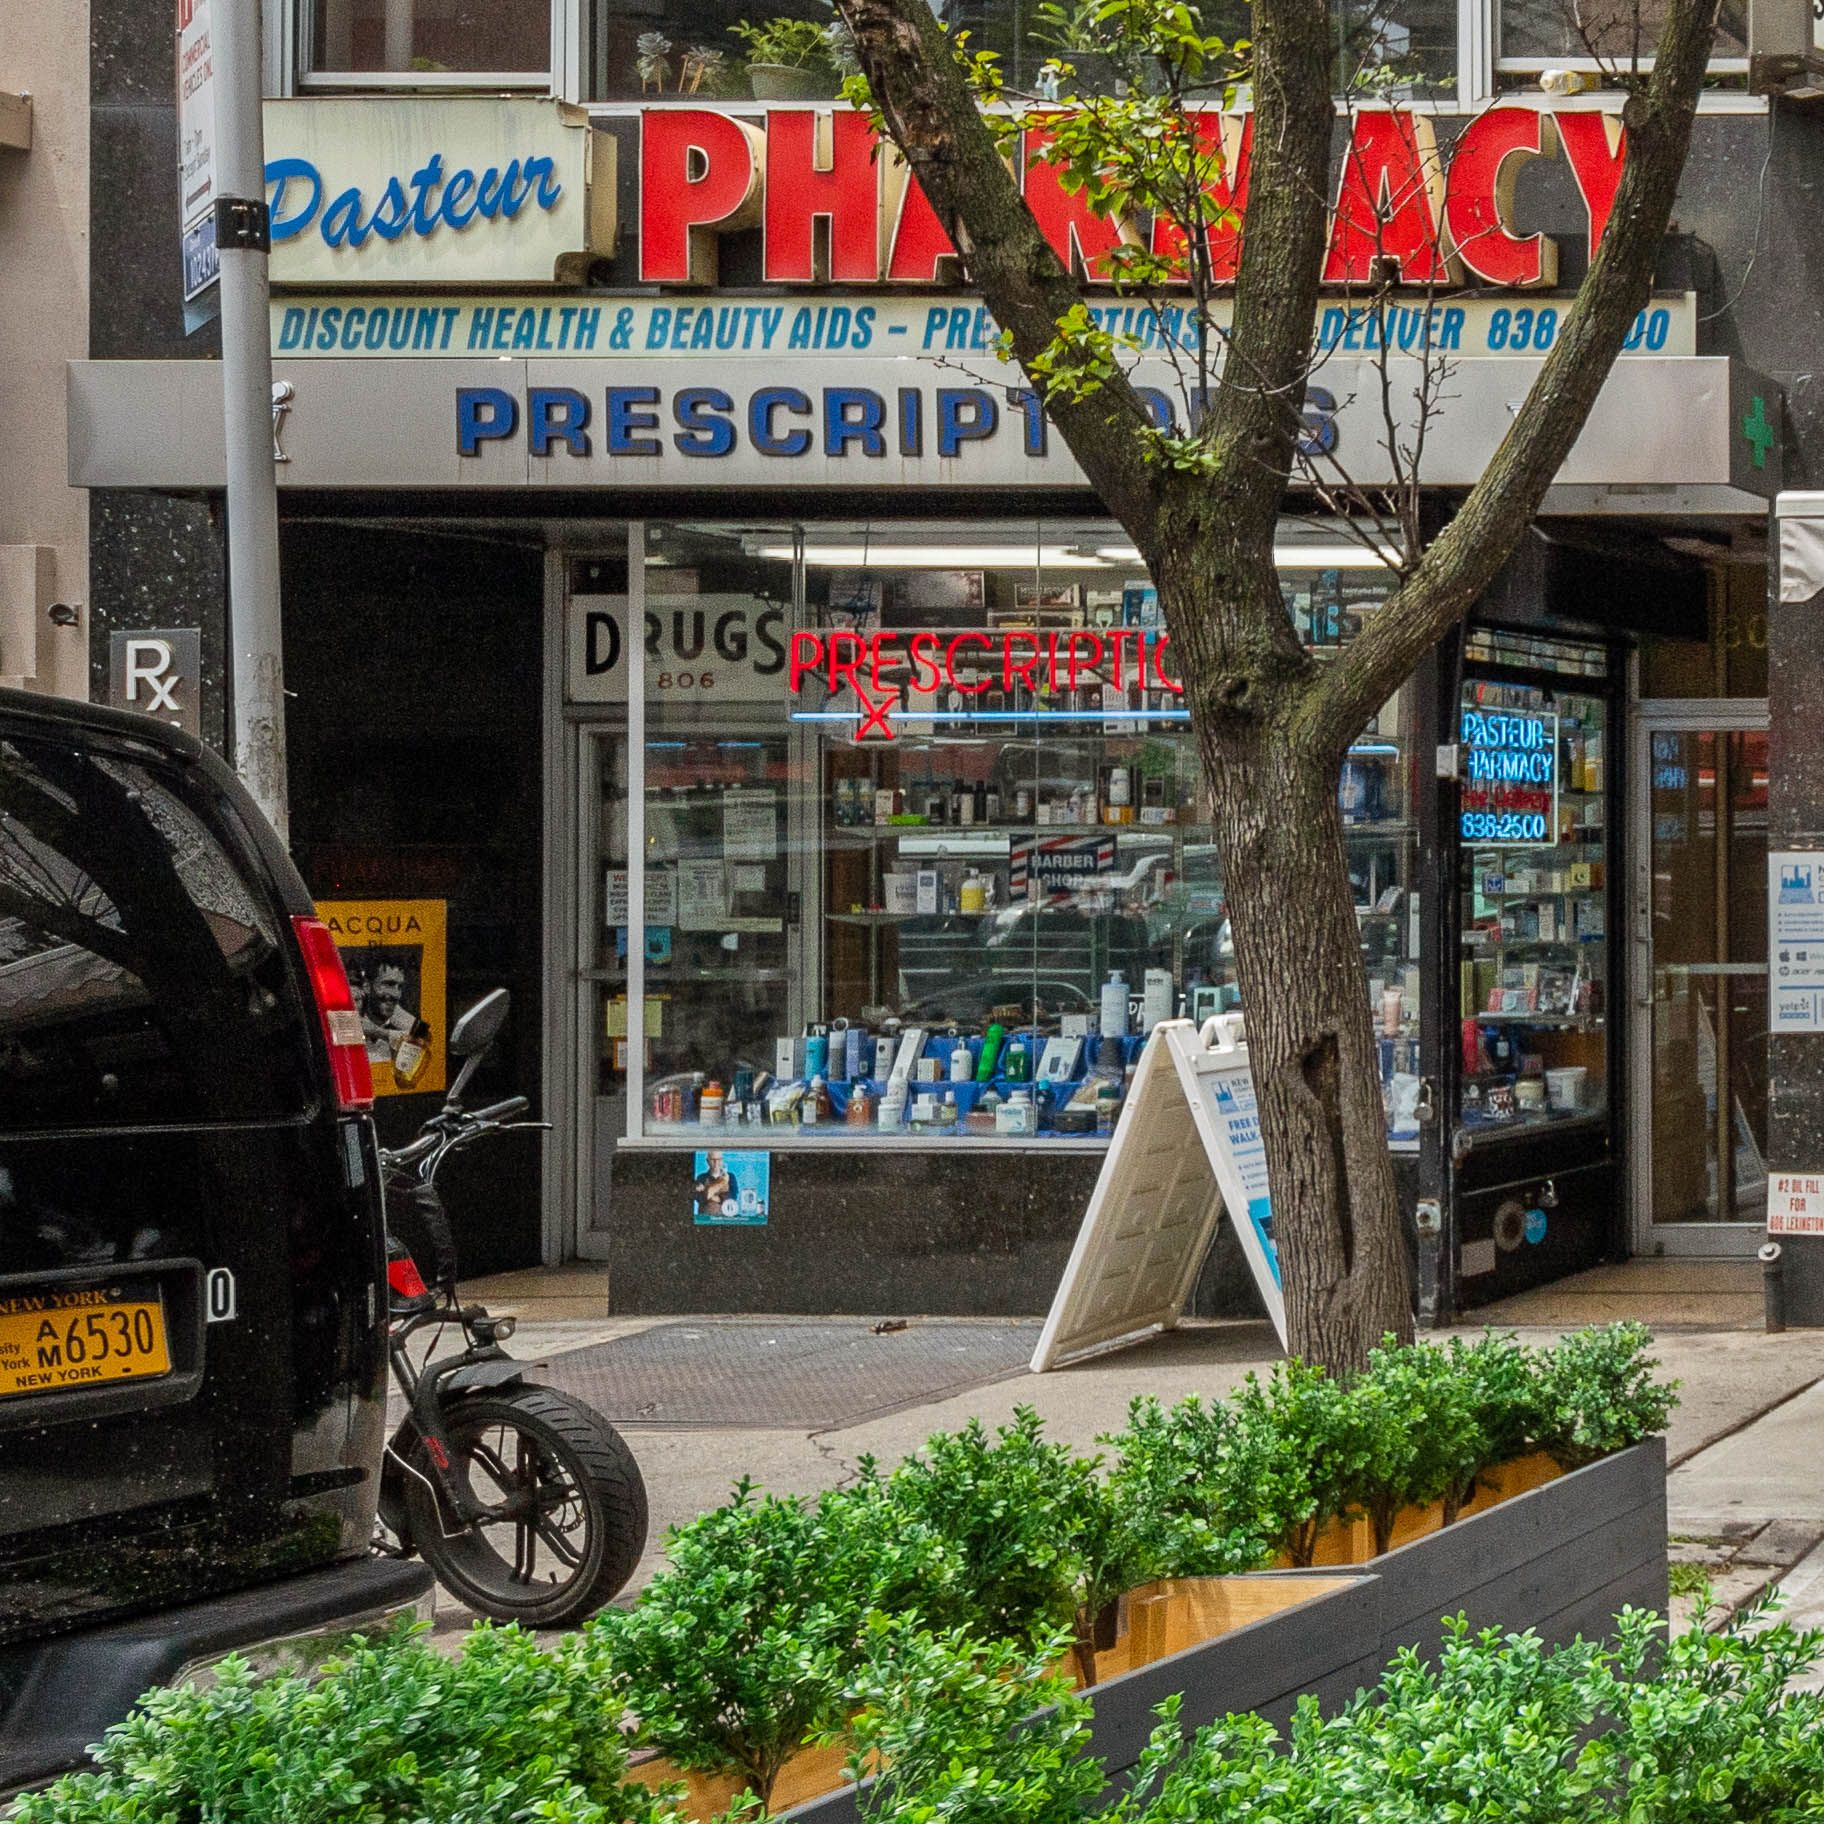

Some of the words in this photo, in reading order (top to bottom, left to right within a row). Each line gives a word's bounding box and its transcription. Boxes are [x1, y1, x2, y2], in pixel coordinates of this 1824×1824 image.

[263, 152, 561, 249] Pasteur
[279, 306, 459, 352] DISCOUNT
[467, 306, 596, 352] HEALTH
[609, 306, 635, 352] &
[645, 306, 783, 352] BEAUTY
[787, 306, 875, 352] AIDS
[1319, 307, 1466, 352] DELIVER
[585, 610, 787, 676] DRUGS
[657, 671, 715, 689] 806
[1031, 855, 1094, 868] BARBER
[328, 916, 422, 934] ACQUA
[1790, 1197, 1806, 1212] FOR
[51, 1290, 109, 1308] YORK
[66, 1308, 154, 1364] 6530
[16, 1370, 53, 1388] NEW
[57, 1365, 103, 1383] YORK
